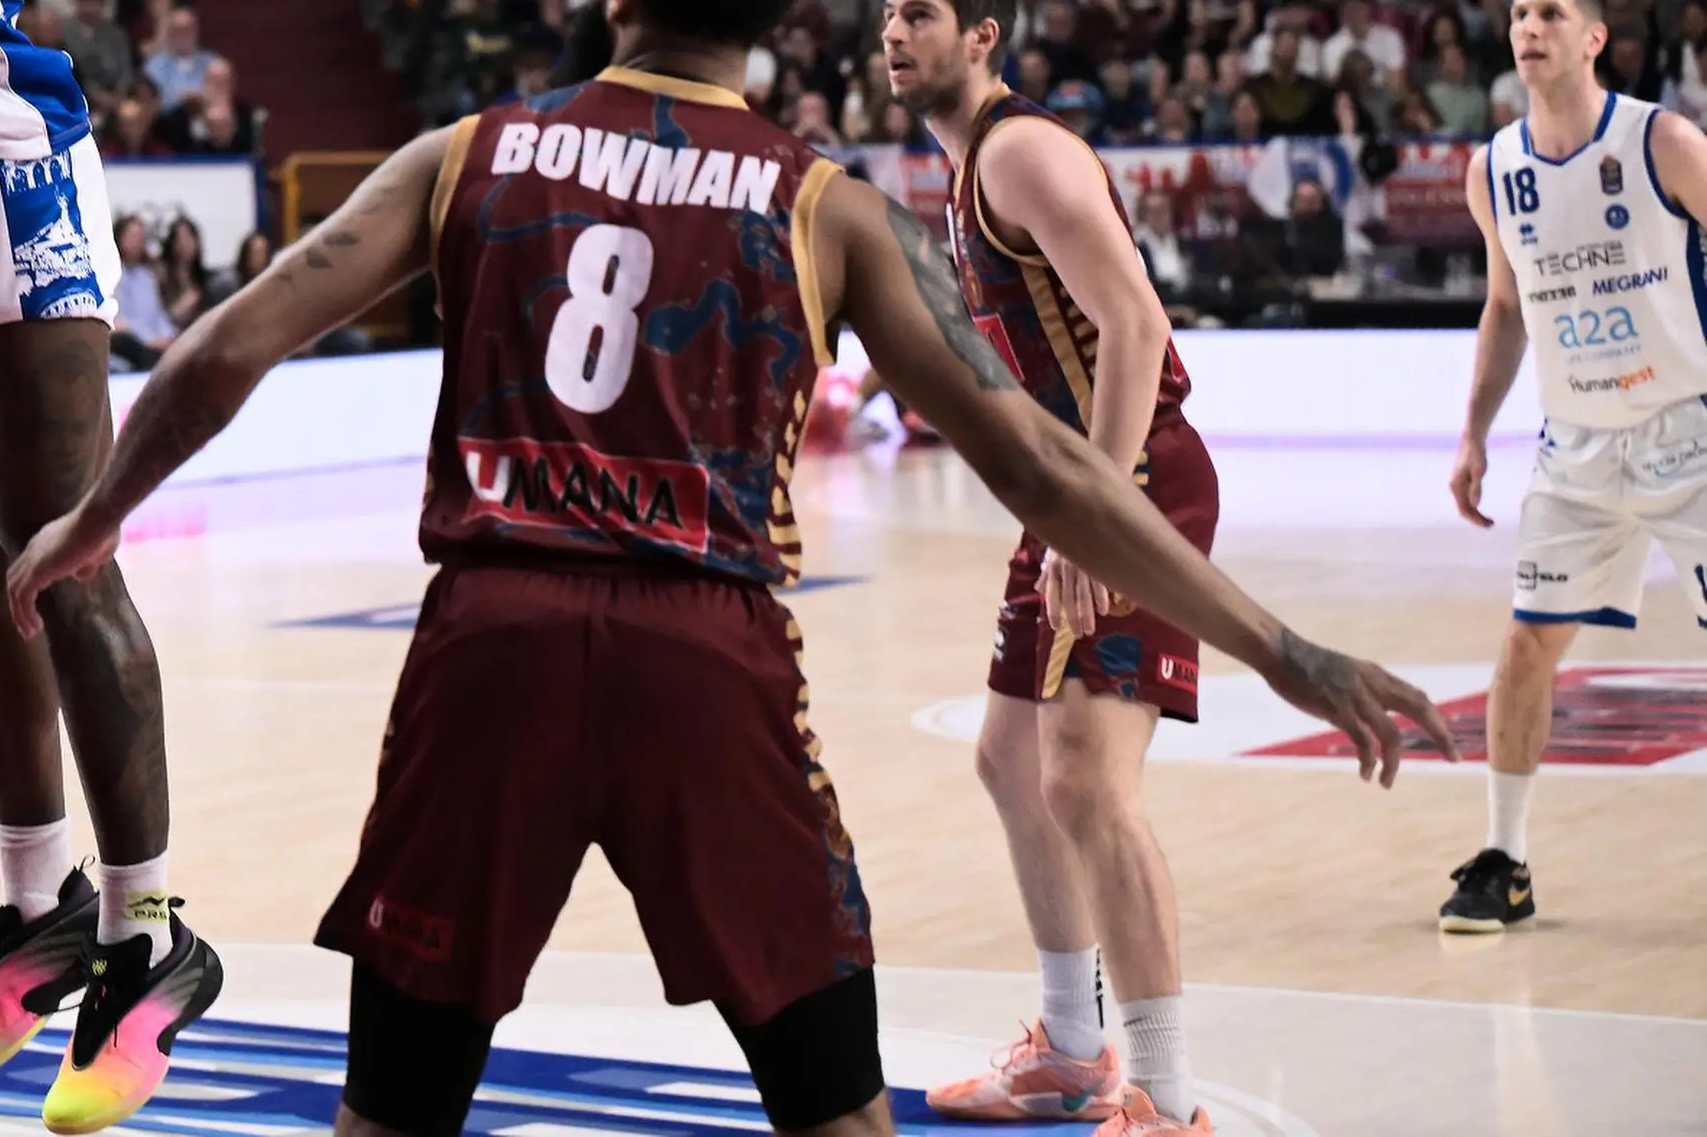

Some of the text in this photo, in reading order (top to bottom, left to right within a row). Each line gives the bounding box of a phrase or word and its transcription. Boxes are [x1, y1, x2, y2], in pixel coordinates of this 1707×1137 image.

[491, 123, 781, 214] BOWMAN
[1502, 167, 1540, 216] 18
[1592, 266, 1669, 297] MEGRANI
[545, 223, 654, 414] 8
[1554, 306, 1639, 350] a2a
[464, 451, 684, 529] UMANA
